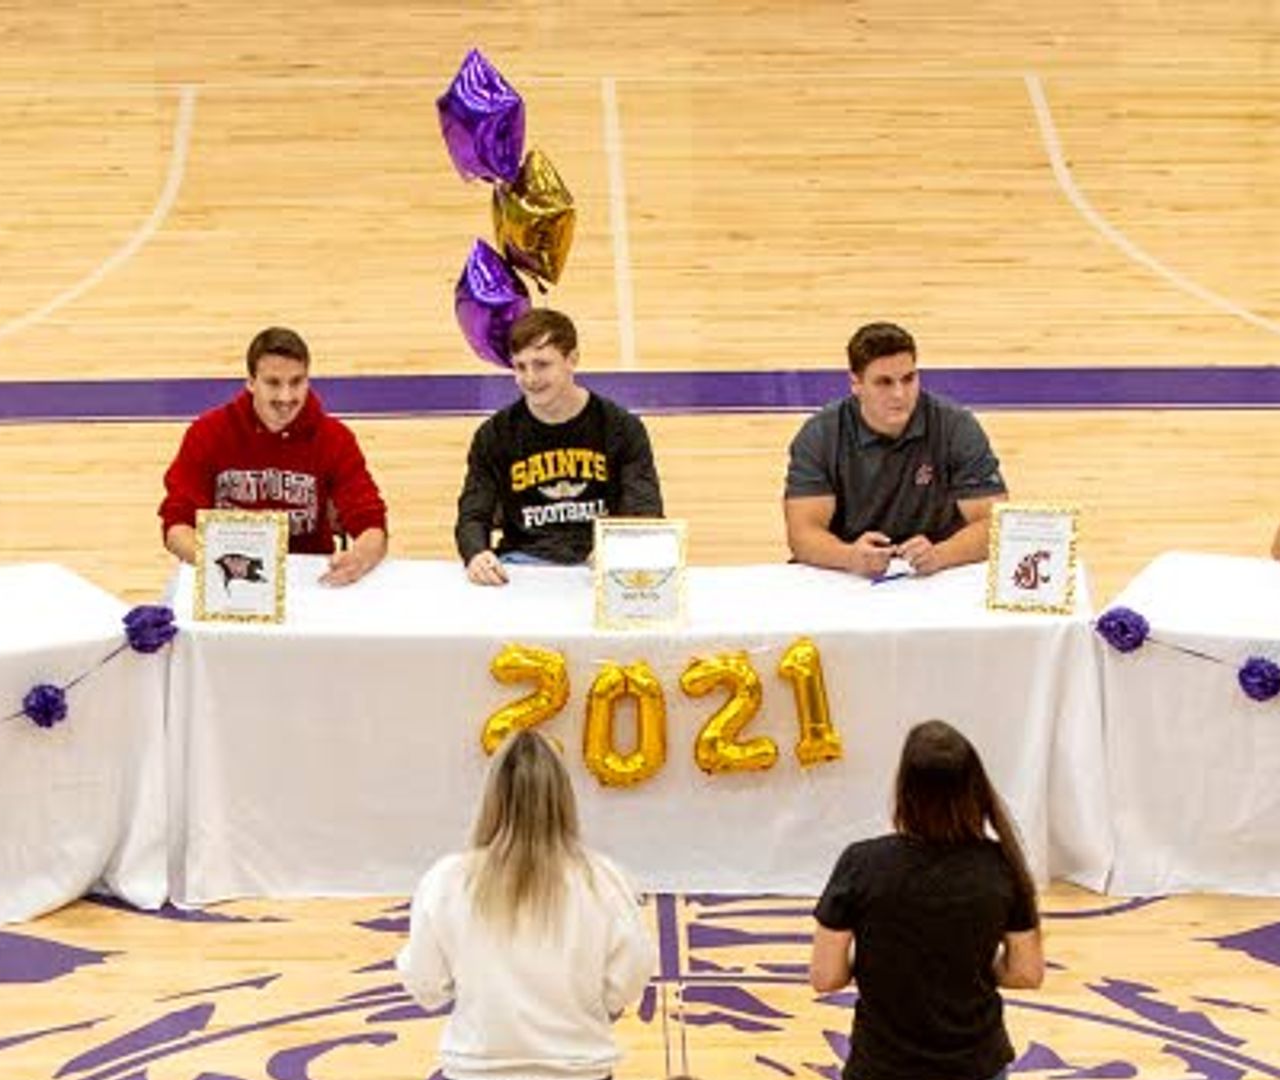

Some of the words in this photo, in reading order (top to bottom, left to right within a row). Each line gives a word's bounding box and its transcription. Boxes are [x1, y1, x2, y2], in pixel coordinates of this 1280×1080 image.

[510, 447, 609, 492] SAINTS
[521, 499, 609, 529] FOOTBALL
[481, 634, 843, 790] 2021
